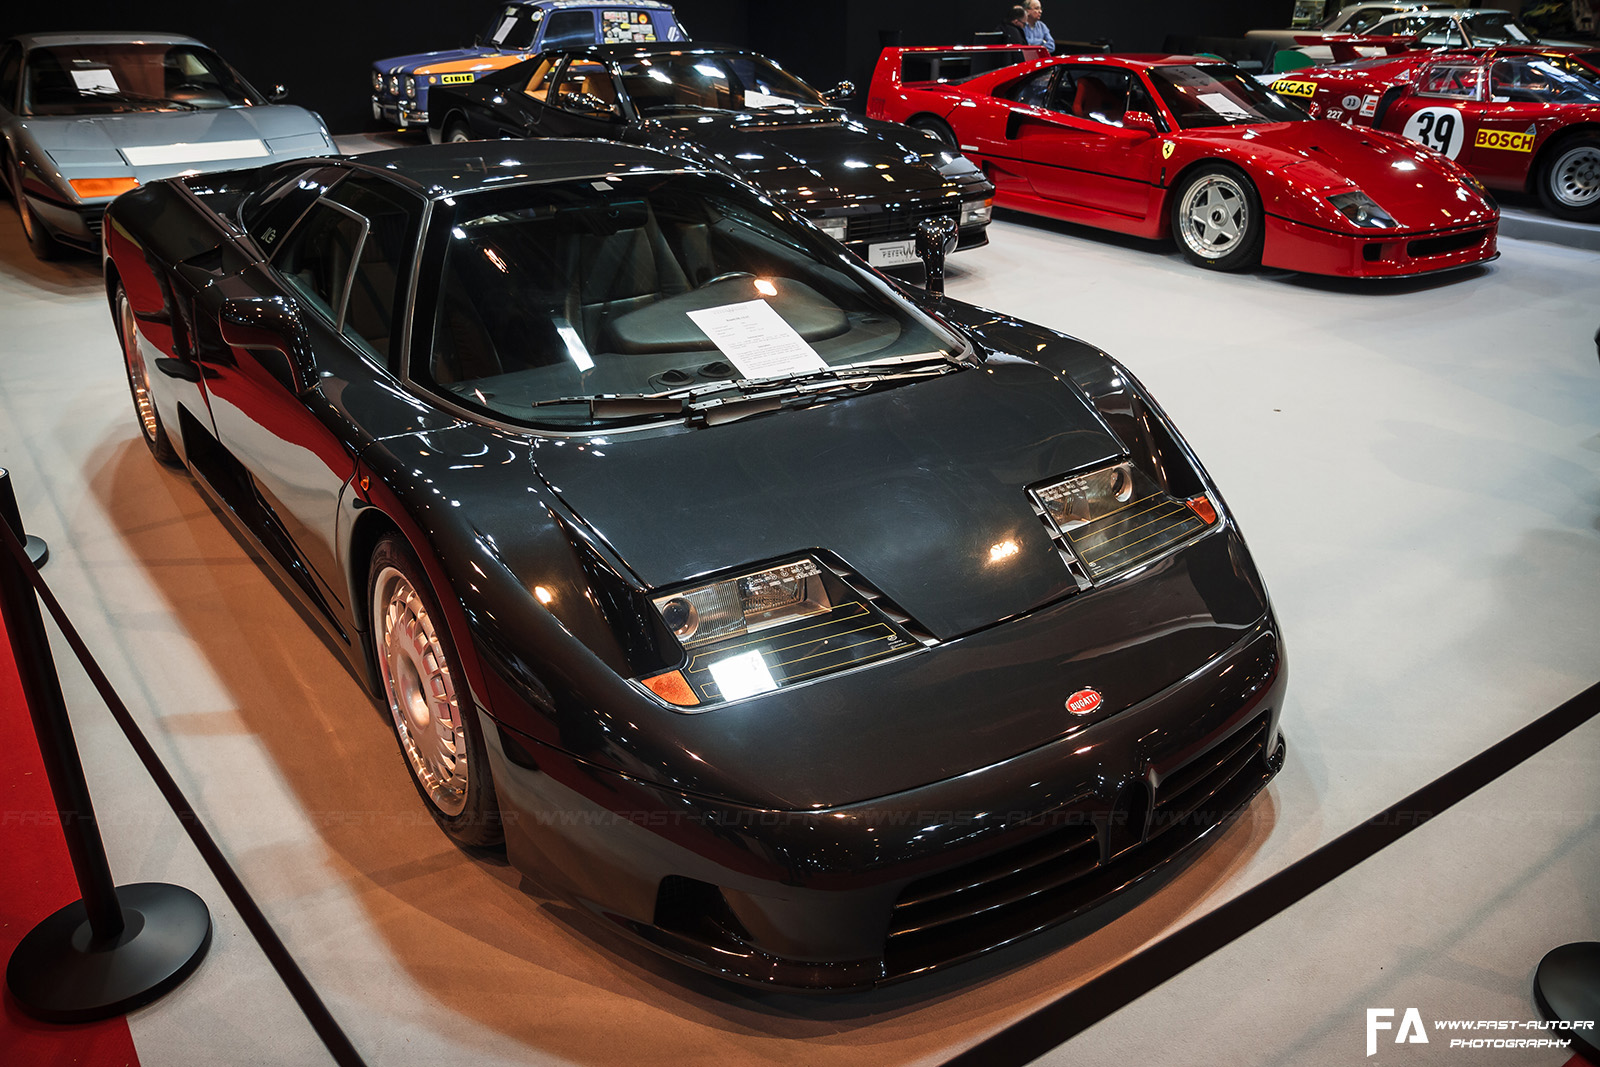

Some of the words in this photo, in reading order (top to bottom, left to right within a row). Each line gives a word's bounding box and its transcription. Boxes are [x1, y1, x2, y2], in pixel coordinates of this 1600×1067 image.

[443, 75, 473, 83] CIBIE
[1273, 82, 1314, 95] LUCAS
[1326, 110, 1343, 119] 227
[1416, 111, 1456, 155] 39
[1476, 131, 1534, 150] BOSCH
[1069, 693, 1099, 711] BUGATTI
